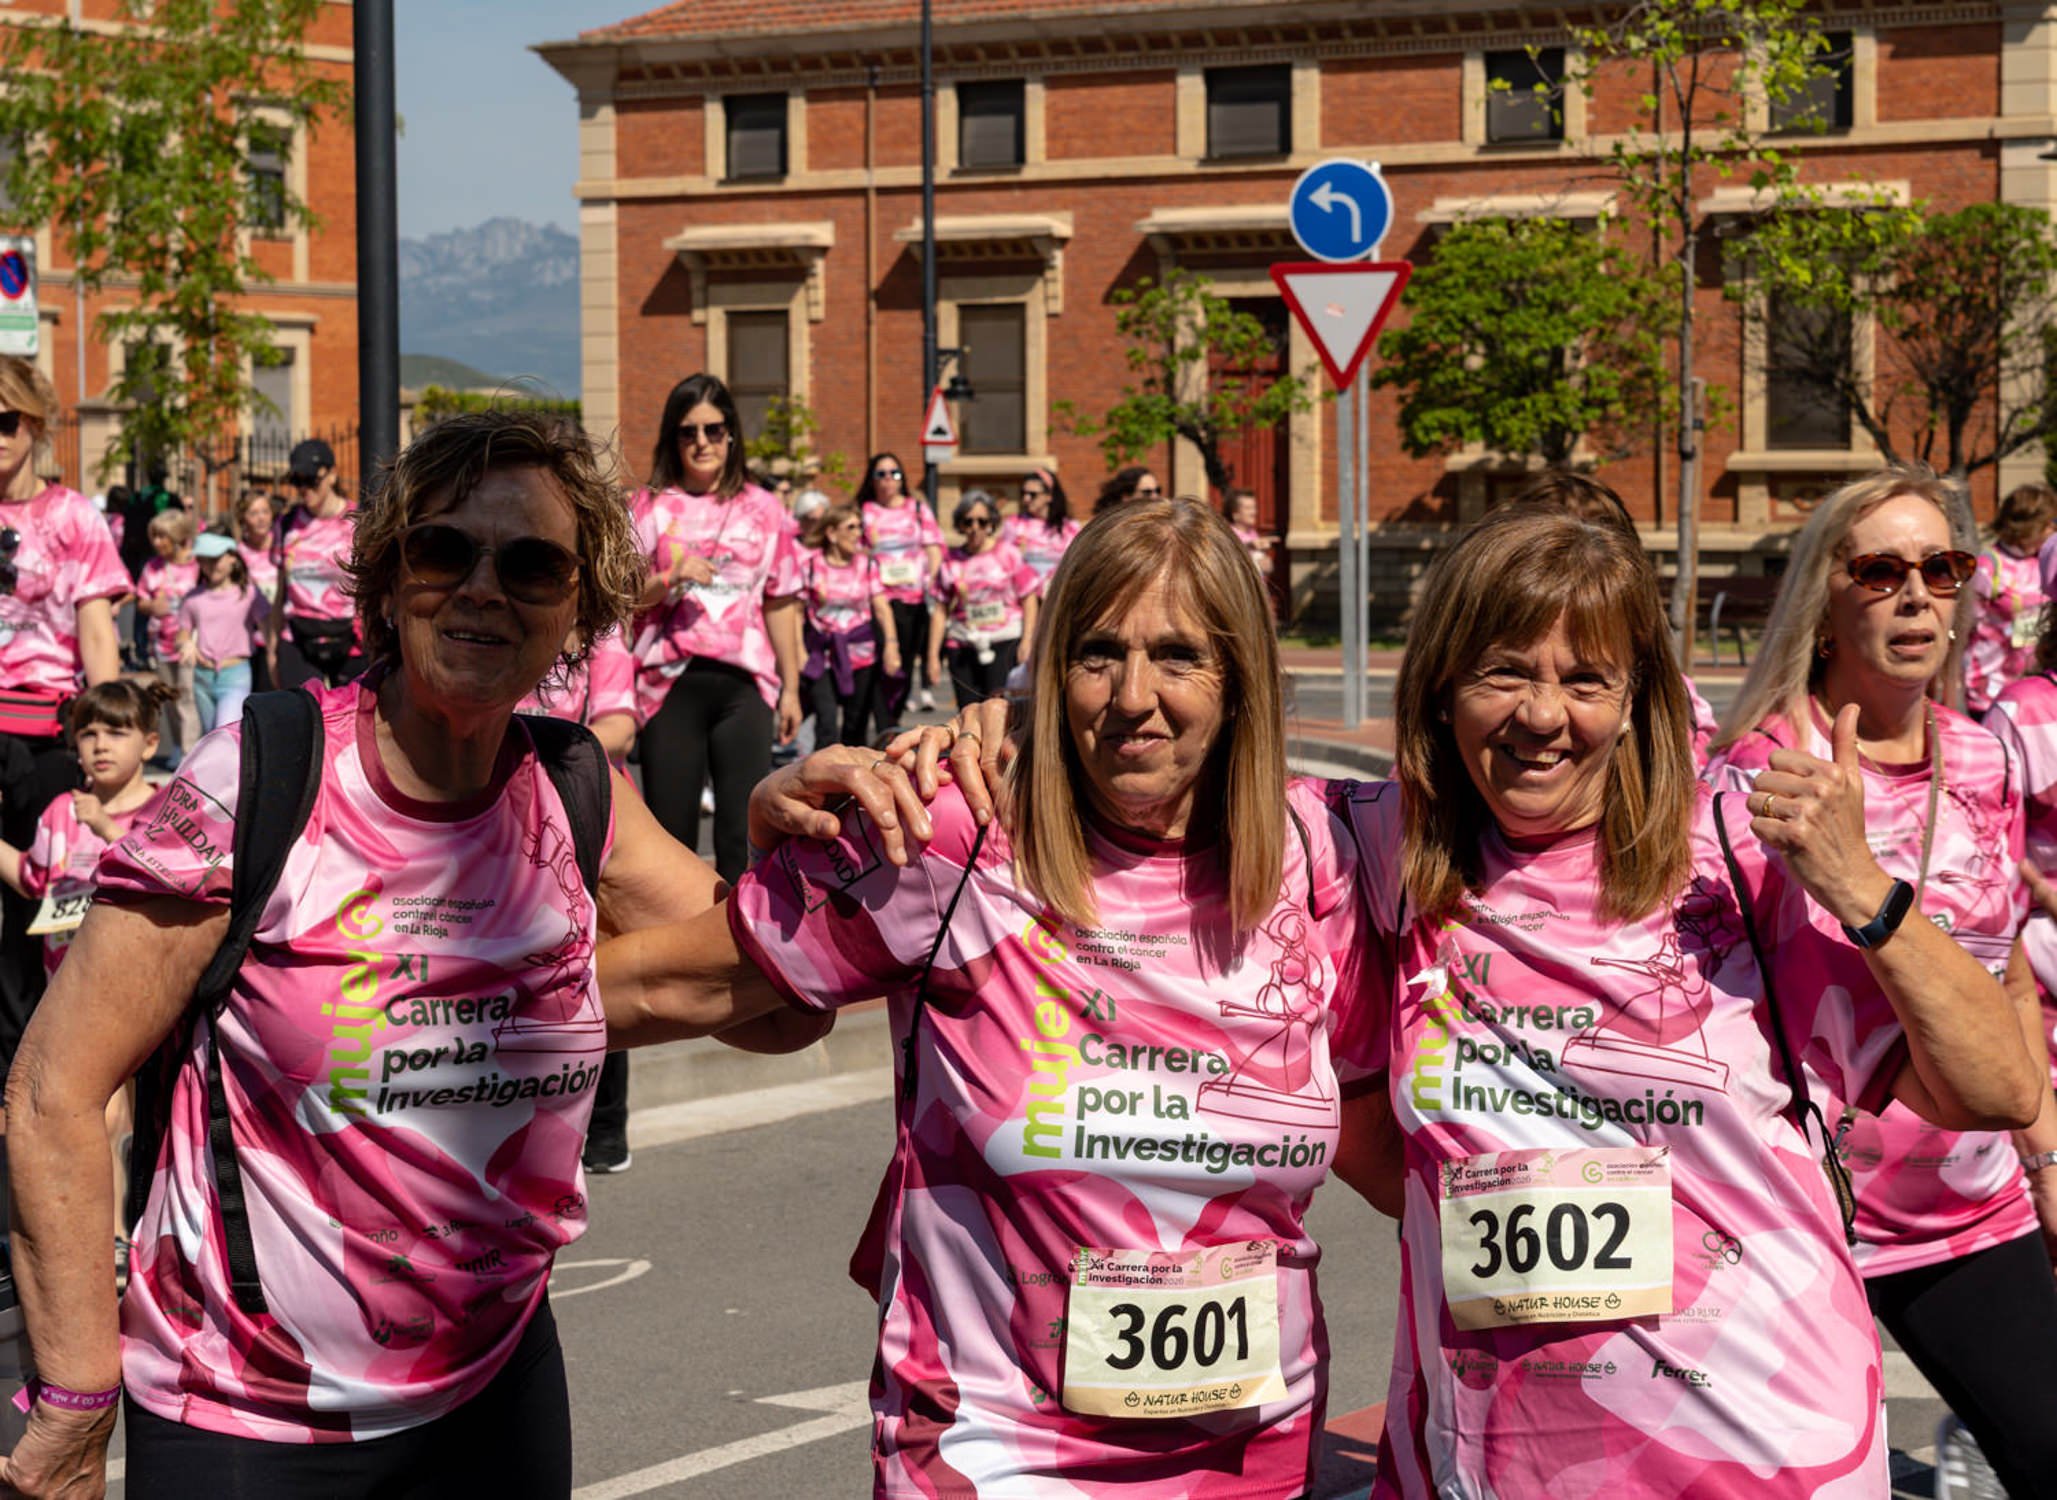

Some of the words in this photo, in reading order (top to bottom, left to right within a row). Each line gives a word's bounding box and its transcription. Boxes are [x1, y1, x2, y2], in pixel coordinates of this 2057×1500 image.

[423, 924, 449, 939] Rioja
[1075, 928, 1137, 943] asociación
[1139, 933, 1188, 946] española
[1075, 942, 1115, 955] contra
[1117, 944, 1128, 955] el
[389, 954, 429, 982] XI
[1076, 955, 1092, 966] en
[1094, 956, 1109, 967] La
[1111, 957, 1142, 972] Rioja
[1460, 952, 1492, 986] XI
[384, 994, 511, 1027] Carrera
[1077, 989, 1117, 1021] XI
[1461, 991, 1596, 1031] Carrera
[381, 1044, 449, 1083] por
[454, 1036, 487, 1065] la
[1020, 973, 1082, 1159] mujer
[1078, 1032, 1230, 1075] Carrera
[1453, 1037, 1520, 1072] por
[1521, 1039, 1557, 1075] la
[376, 1060, 599, 1115] Investigación
[1076, 1085, 1144, 1121] por
[1153, 1084, 1190, 1121] la
[1452, 1076, 1705, 1131] Investigación
[1073, 1125, 1327, 1174] Investigación
[1465, 1167, 1499, 1179] Carrera
[1501, 1166, 1516, 1176] por
[1468, 1202, 1633, 1279] 3602
[1107, 1262, 1149, 1273] Carrera
[1151, 1264, 1171, 1275] por
[1507, 1296, 1550, 1312] NATUR
[1553, 1296, 1602, 1310] HOUSE
[1105, 1296, 1249, 1371] 3601
[1143, 1392, 1188, 1406] NATUR
[1191, 1388, 1228, 1404] HOUSE
